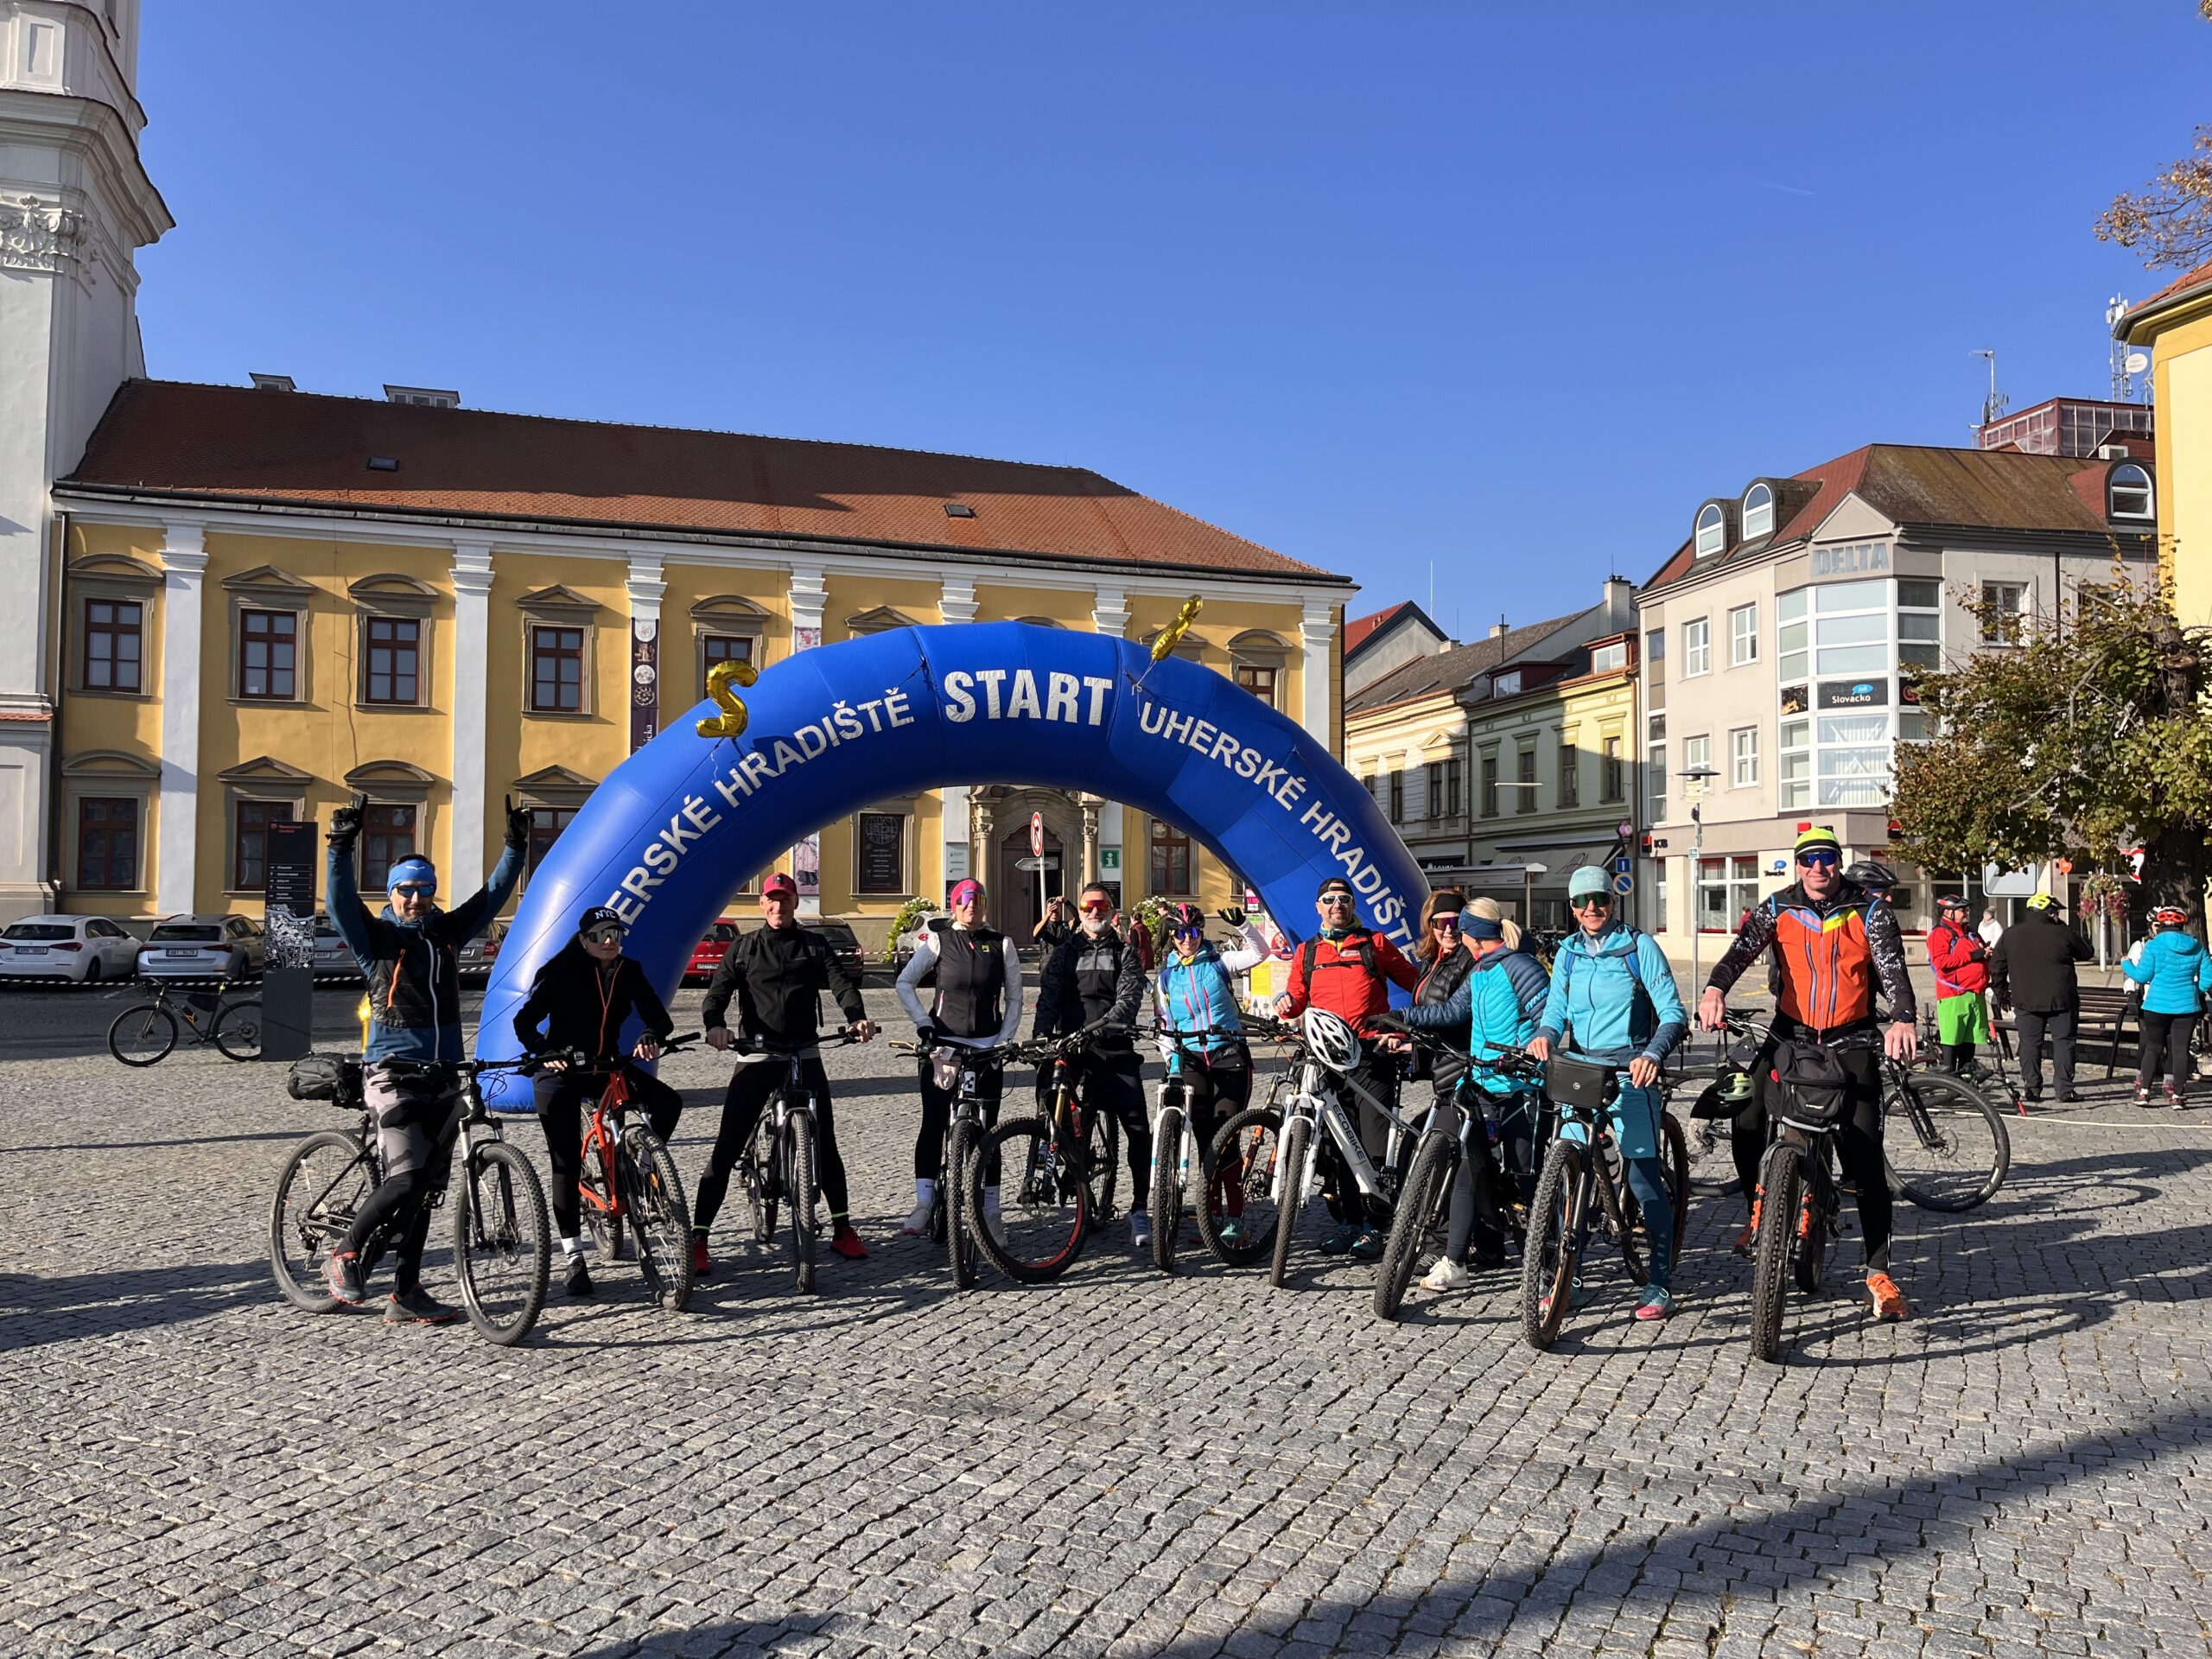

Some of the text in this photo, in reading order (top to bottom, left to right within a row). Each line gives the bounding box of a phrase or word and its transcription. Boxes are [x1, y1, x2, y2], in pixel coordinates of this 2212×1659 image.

[1812, 543, 1890, 576] DELTA
[944, 669, 1113, 726] START
[1140, 701, 1307, 812] UHERSKÉ
[604, 687, 915, 937] ERSKÉ HRADIŠTĚ
[594, 909, 616, 919] NYC
[1332, 1104, 1365, 1160] ECOBIKE
